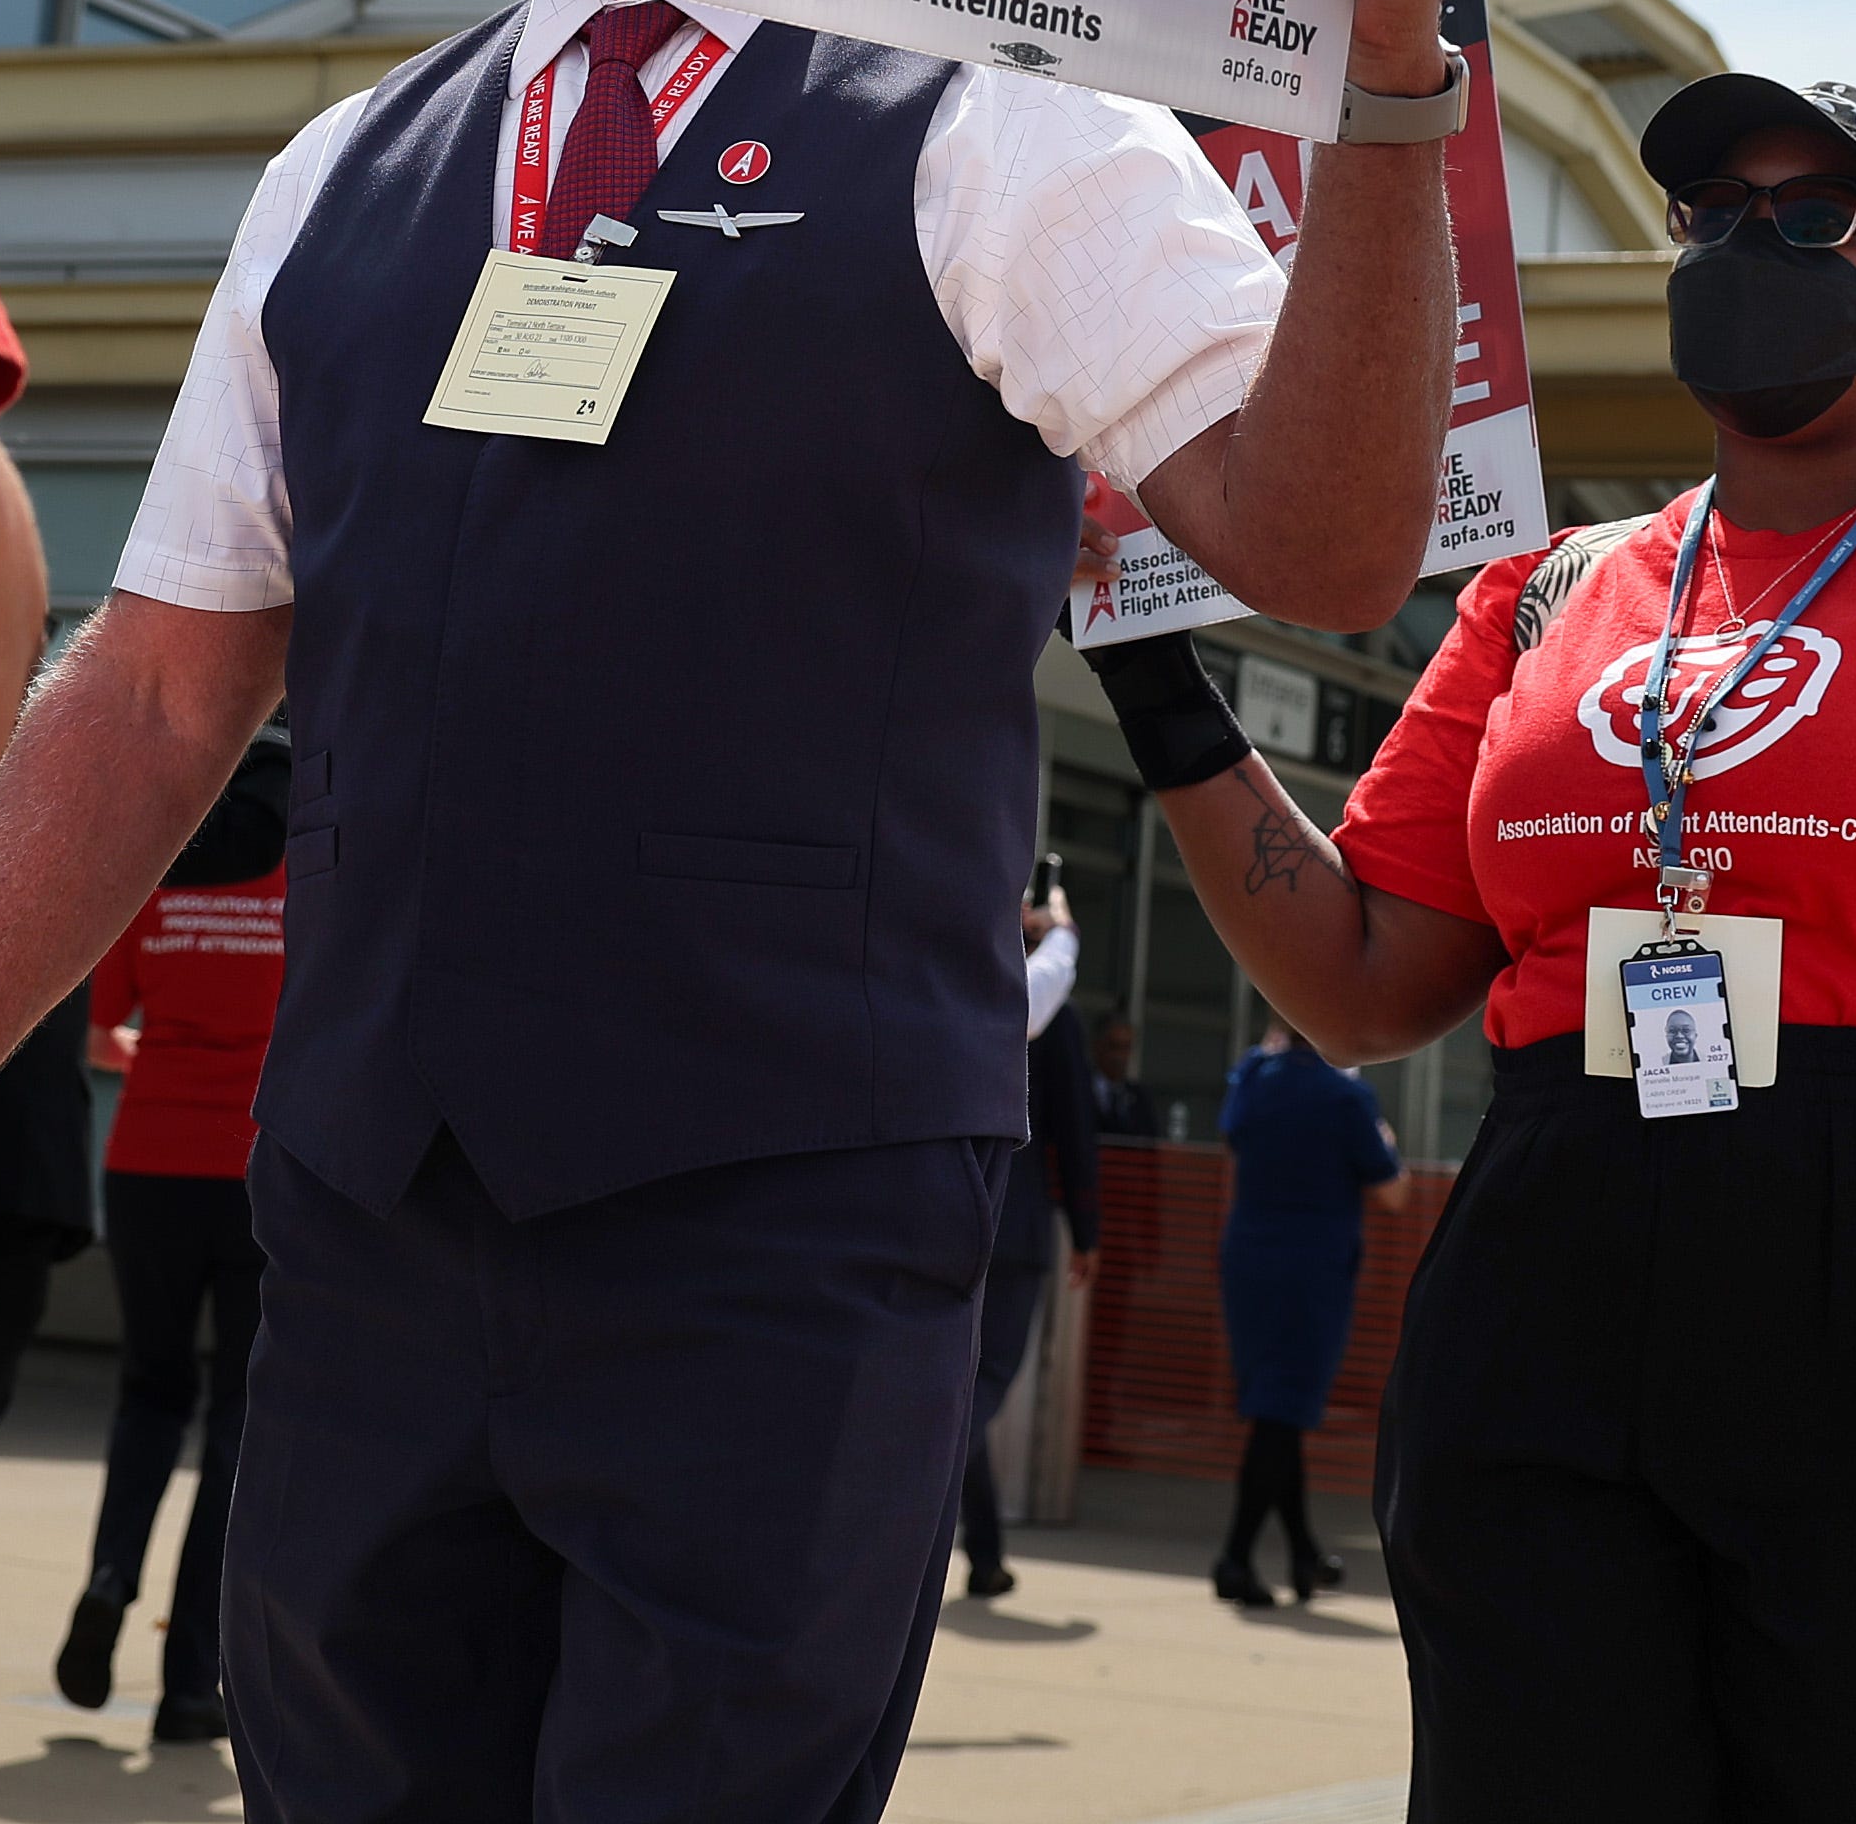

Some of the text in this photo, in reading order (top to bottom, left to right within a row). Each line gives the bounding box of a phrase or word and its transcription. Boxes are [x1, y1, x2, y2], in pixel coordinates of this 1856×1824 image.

[1229, 6, 1318, 56] READY
[666, 50, 712, 99] READY
[1221, 57, 1302, 96] apfa.org
[521, 73, 548, 168] WE ARE READY
[516, 210, 537, 241] WE
[526, 297, 598, 311] DEMONSTRATION PERMIT
[576, 399, 596, 415] 29
[1438, 490, 1502, 525] READY
[1440, 519, 1515, 550] apfa.org
[1120, 591, 1170, 617] Flight
[1497, 811, 1603, 842] Association
[1610, 812, 1633, 833] of
[1639, 811, 1700, 835] Fht
[1633, 847, 1733, 872] AF-CIO
[1661, 964, 1693, 975] NORSE
[1651, 984, 1697, 1002] CREW
[1707, 1053, 1729, 1062] 2027
[1643, 1068, 1671, 1077] JACAS
